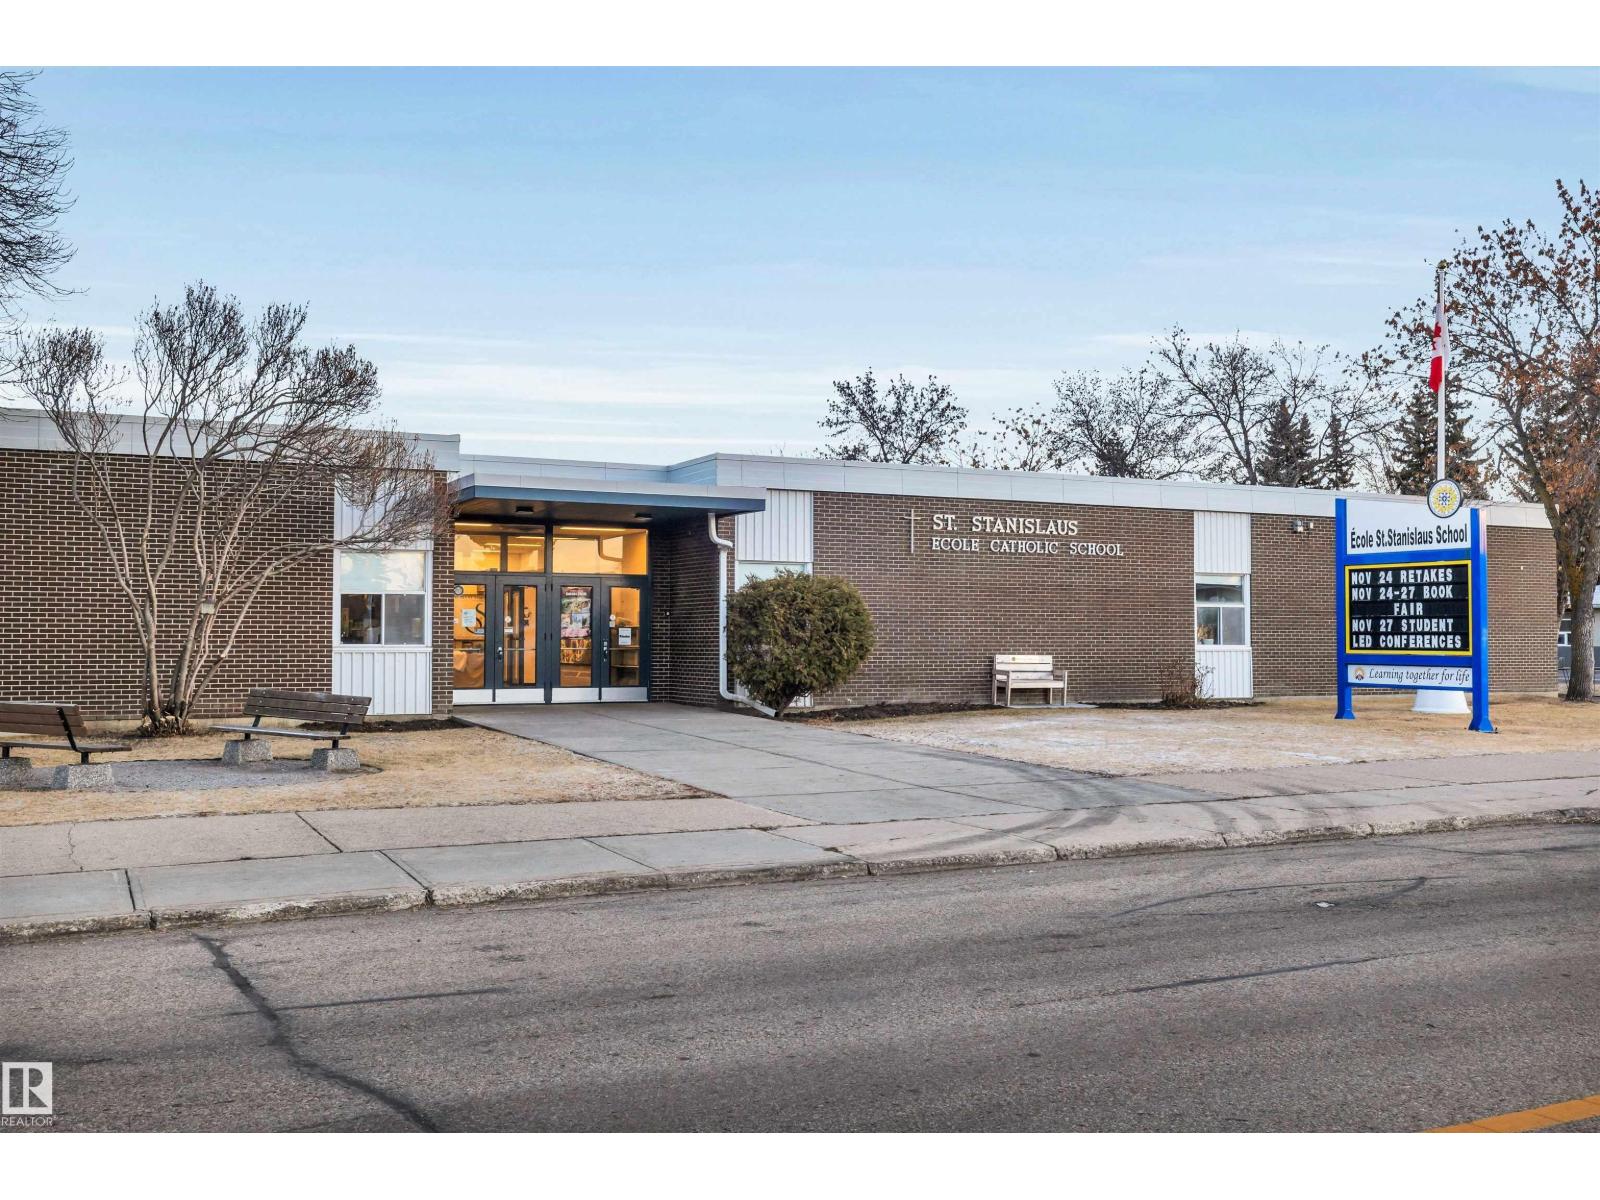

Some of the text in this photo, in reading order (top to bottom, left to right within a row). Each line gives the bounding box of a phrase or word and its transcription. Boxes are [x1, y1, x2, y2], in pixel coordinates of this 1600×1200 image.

[932, 513, 1078, 536] ST. STANISLAUS
[1350, 528, 1373, 549] École
[1436, 523, 1468, 544] School
[931, 537, 1124, 556] ECOLE CATHOLIC SCHOOL
[1351, 568, 1453, 585] NOV 24 RETAKES
[1352, 585, 1453, 600] NOV 24-27 BOOK
[1393, 602, 1423, 616] FAIR
[1352, 618, 1454, 632] NOV 27 STUDENT
[1352, 634, 1462, 648] LED CONFERENCES
[1369, 668, 1470, 685] Learning together for life
